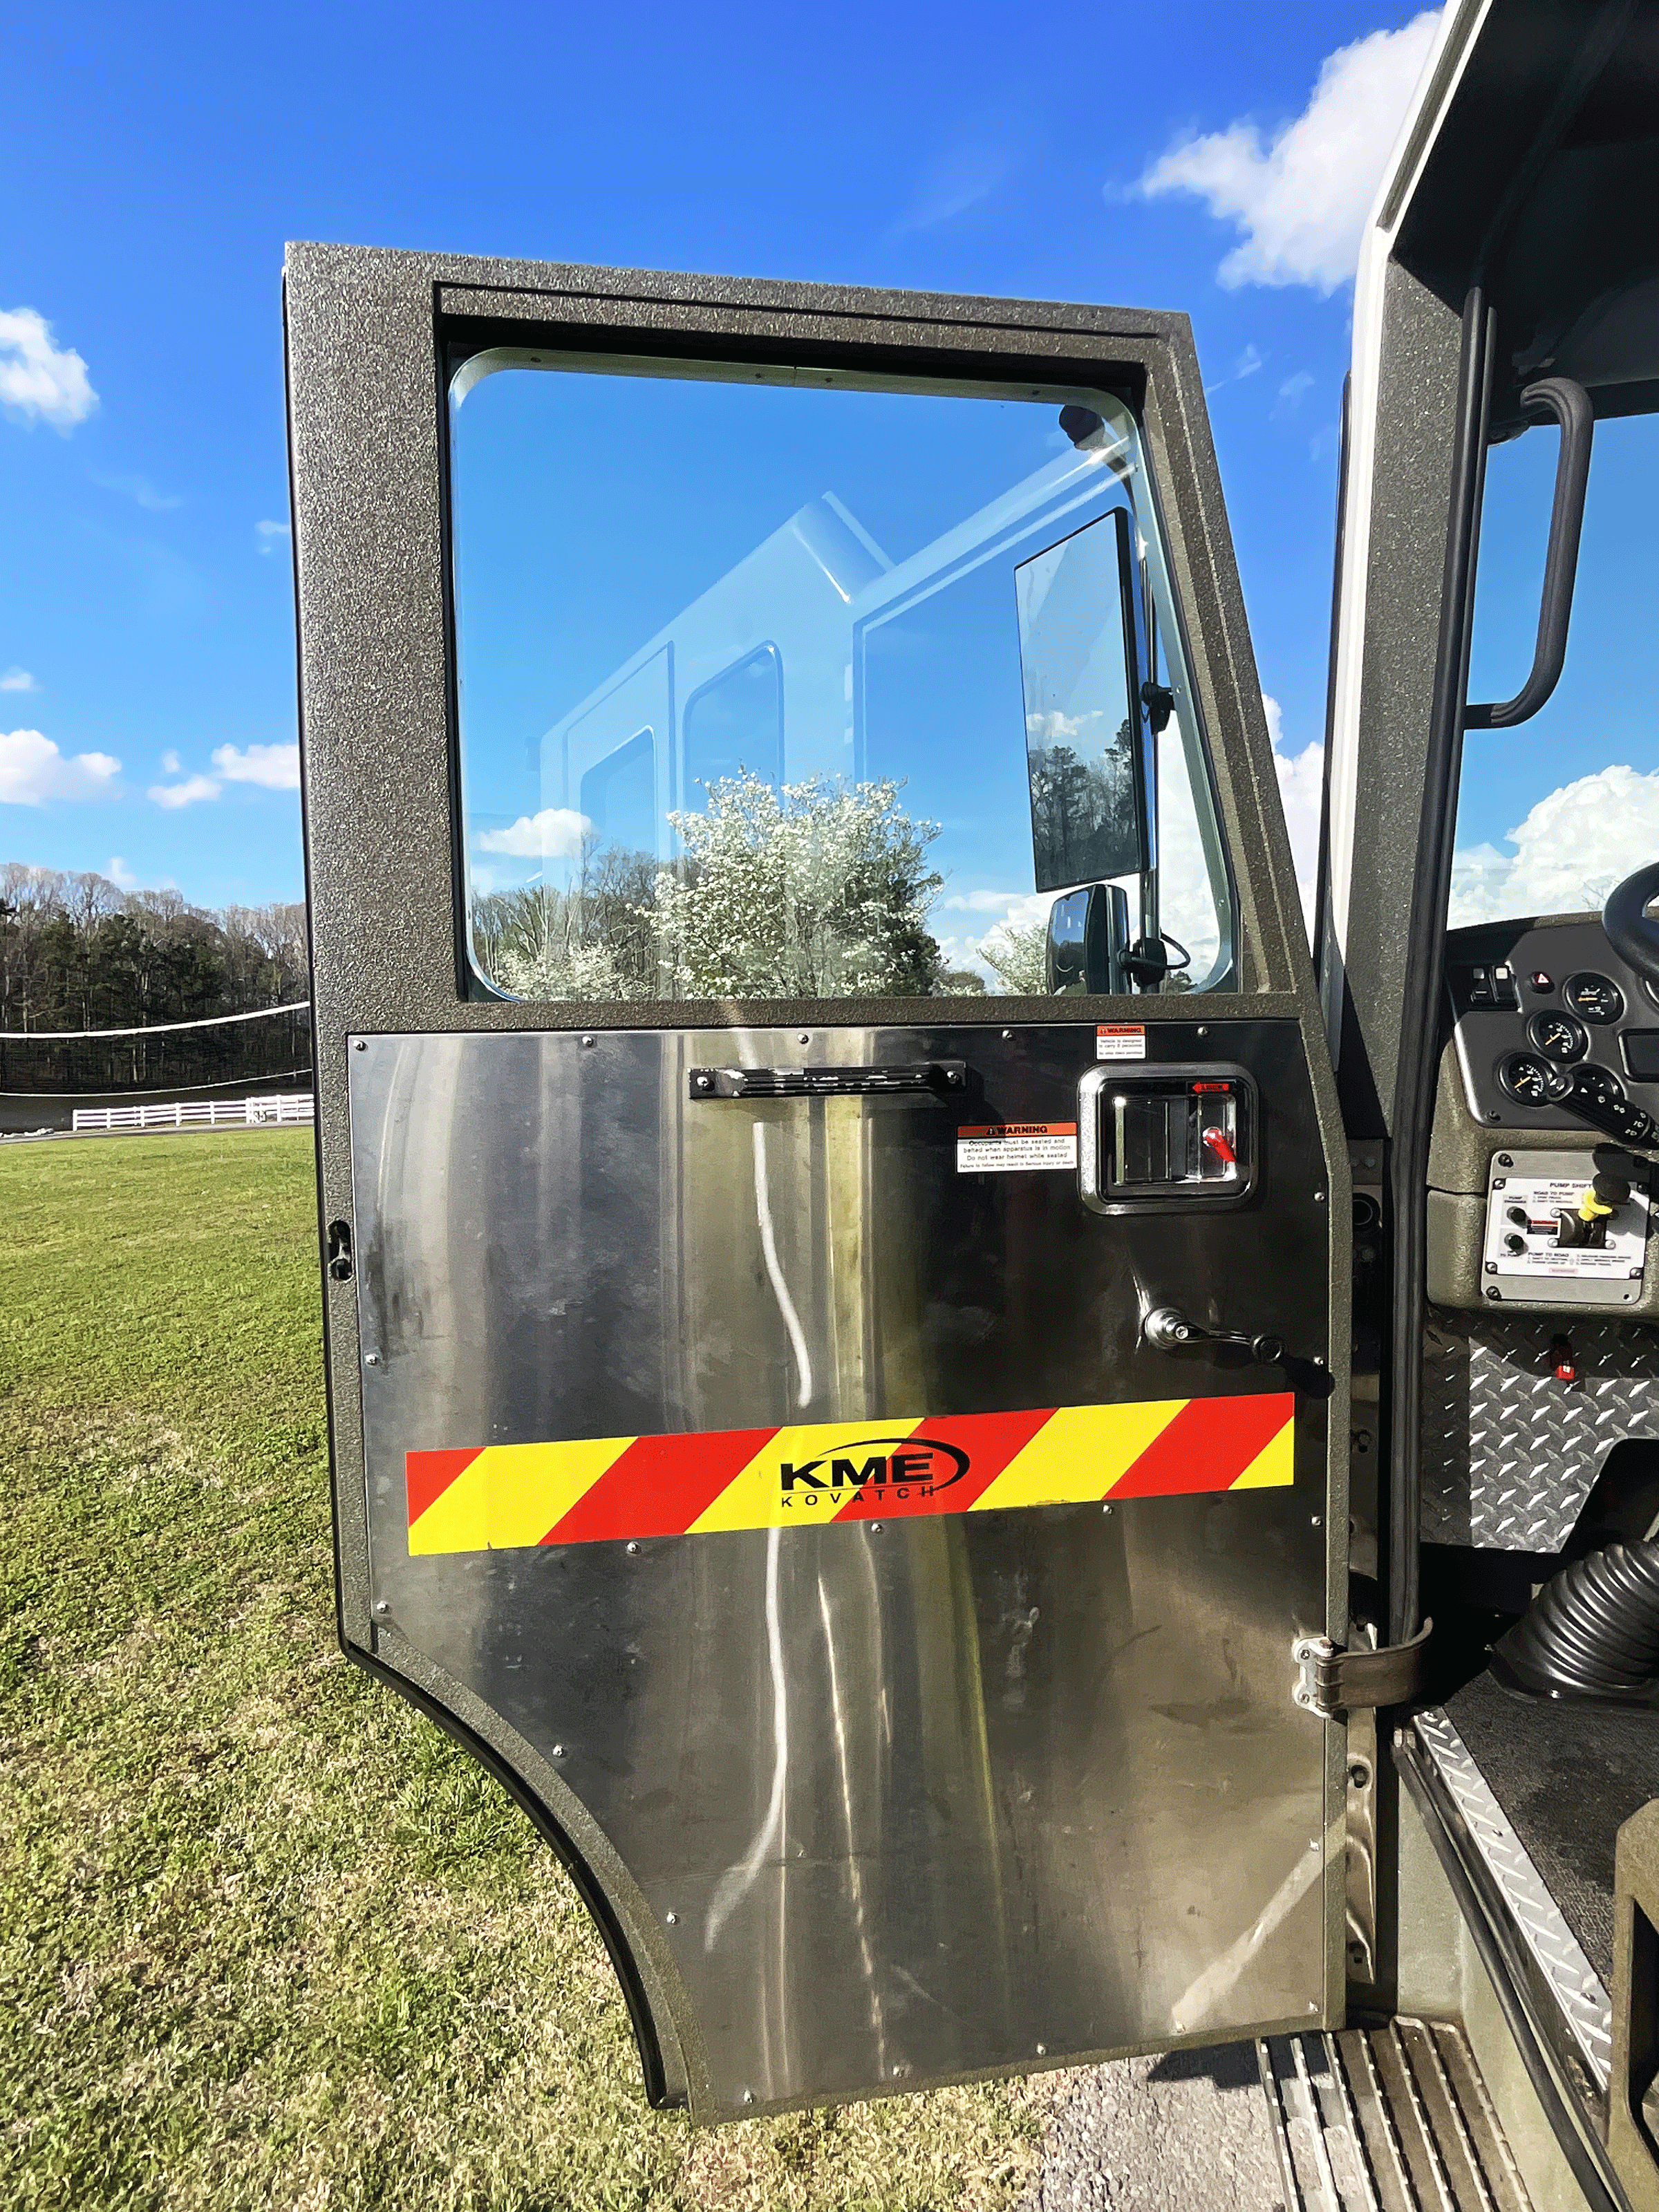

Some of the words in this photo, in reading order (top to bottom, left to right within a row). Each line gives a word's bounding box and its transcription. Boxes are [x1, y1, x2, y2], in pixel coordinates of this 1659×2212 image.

[997, 1125, 1048, 1134] WARNING
[780, 1452, 933, 1490] KME
[782, 1486, 934, 1507] KOVATCH
